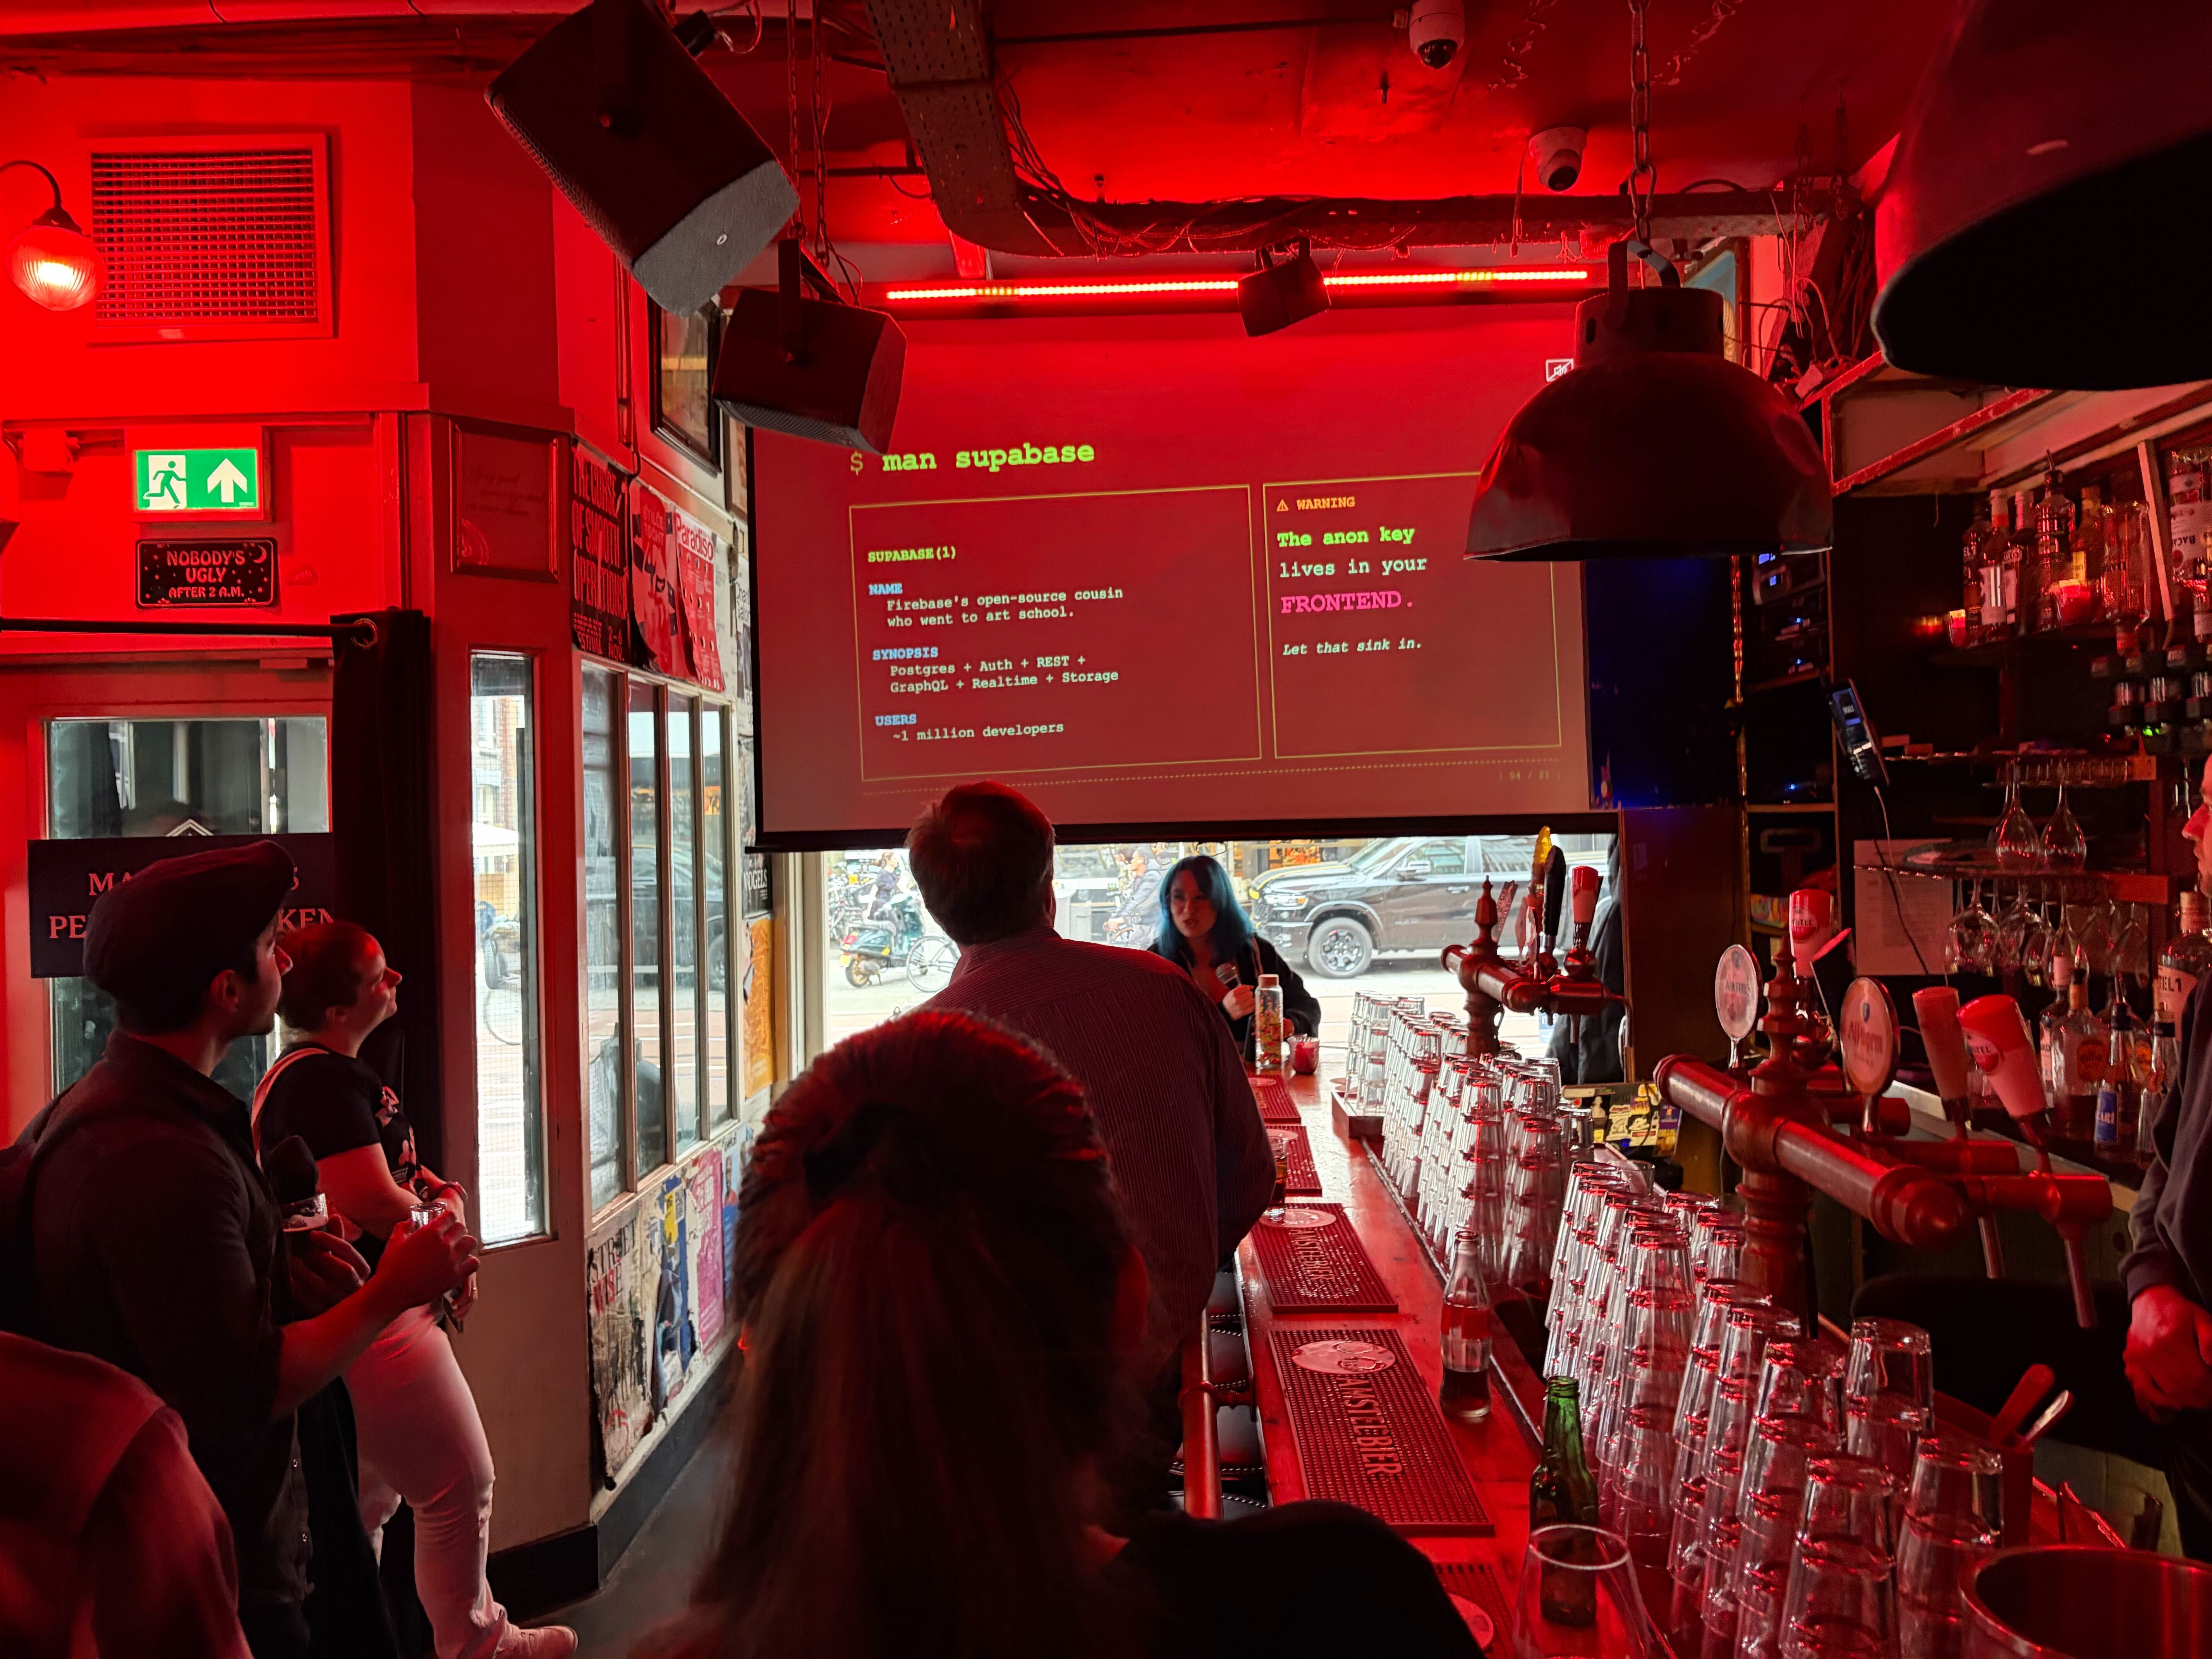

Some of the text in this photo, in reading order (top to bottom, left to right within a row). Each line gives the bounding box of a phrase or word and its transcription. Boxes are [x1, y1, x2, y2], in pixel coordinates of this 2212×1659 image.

[851, 443, 1094, 475] $ man supabase
[1297, 496, 1355, 510] WARNING
[673, 511, 714, 561] Paradiso
[1277, 527, 1415, 547] The anon key
[167, 550, 245, 566] NOBODY'S
[868, 546, 955, 562] SUPABASE(1)
[185, 567, 227, 583] UGLY
[1280, 559, 1427, 577] lives in your
[169, 586, 245, 599] AFTER 2 A.M.
[869, 583, 903, 595] NAME
[886, 587, 1123, 611] Firebase's open-source cousin
[888, 606, 1073, 627] who went to art school.
[873, 647, 938, 660] SYNOPSIS
[1283, 638, 1420, 655] Let that sink in.
[891, 656, 1085, 677] Postgres + Auth + REST +
[891, 672, 1118, 694] GraphQL + Realtime + Storage
[875, 714, 916, 726] USERS
[893, 724, 1063, 741] ~1 million developers
